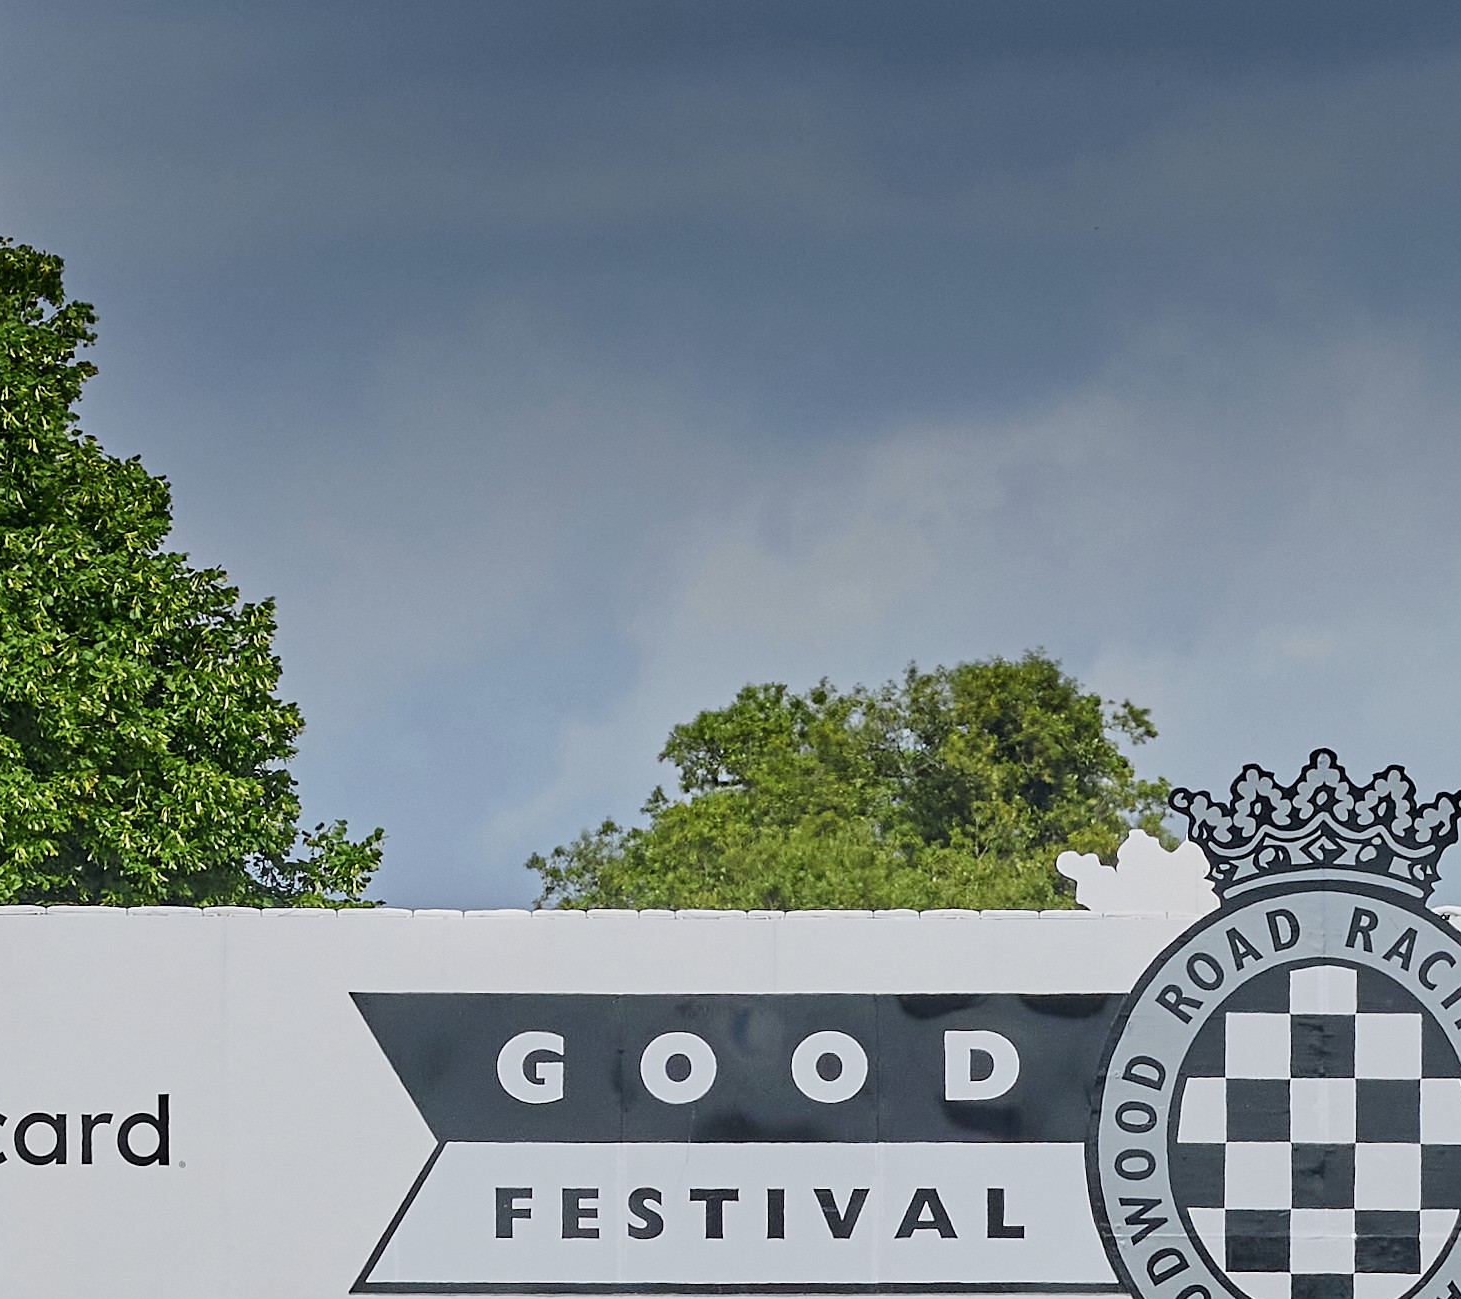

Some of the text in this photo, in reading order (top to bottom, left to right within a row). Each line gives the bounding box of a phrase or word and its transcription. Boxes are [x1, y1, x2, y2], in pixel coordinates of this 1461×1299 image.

[1155, 907, 1302, 1025] ROAD
[495, 1031, 1021, 1104] GOOD
[495, 1187, 1026, 1239] FESTIVAL
